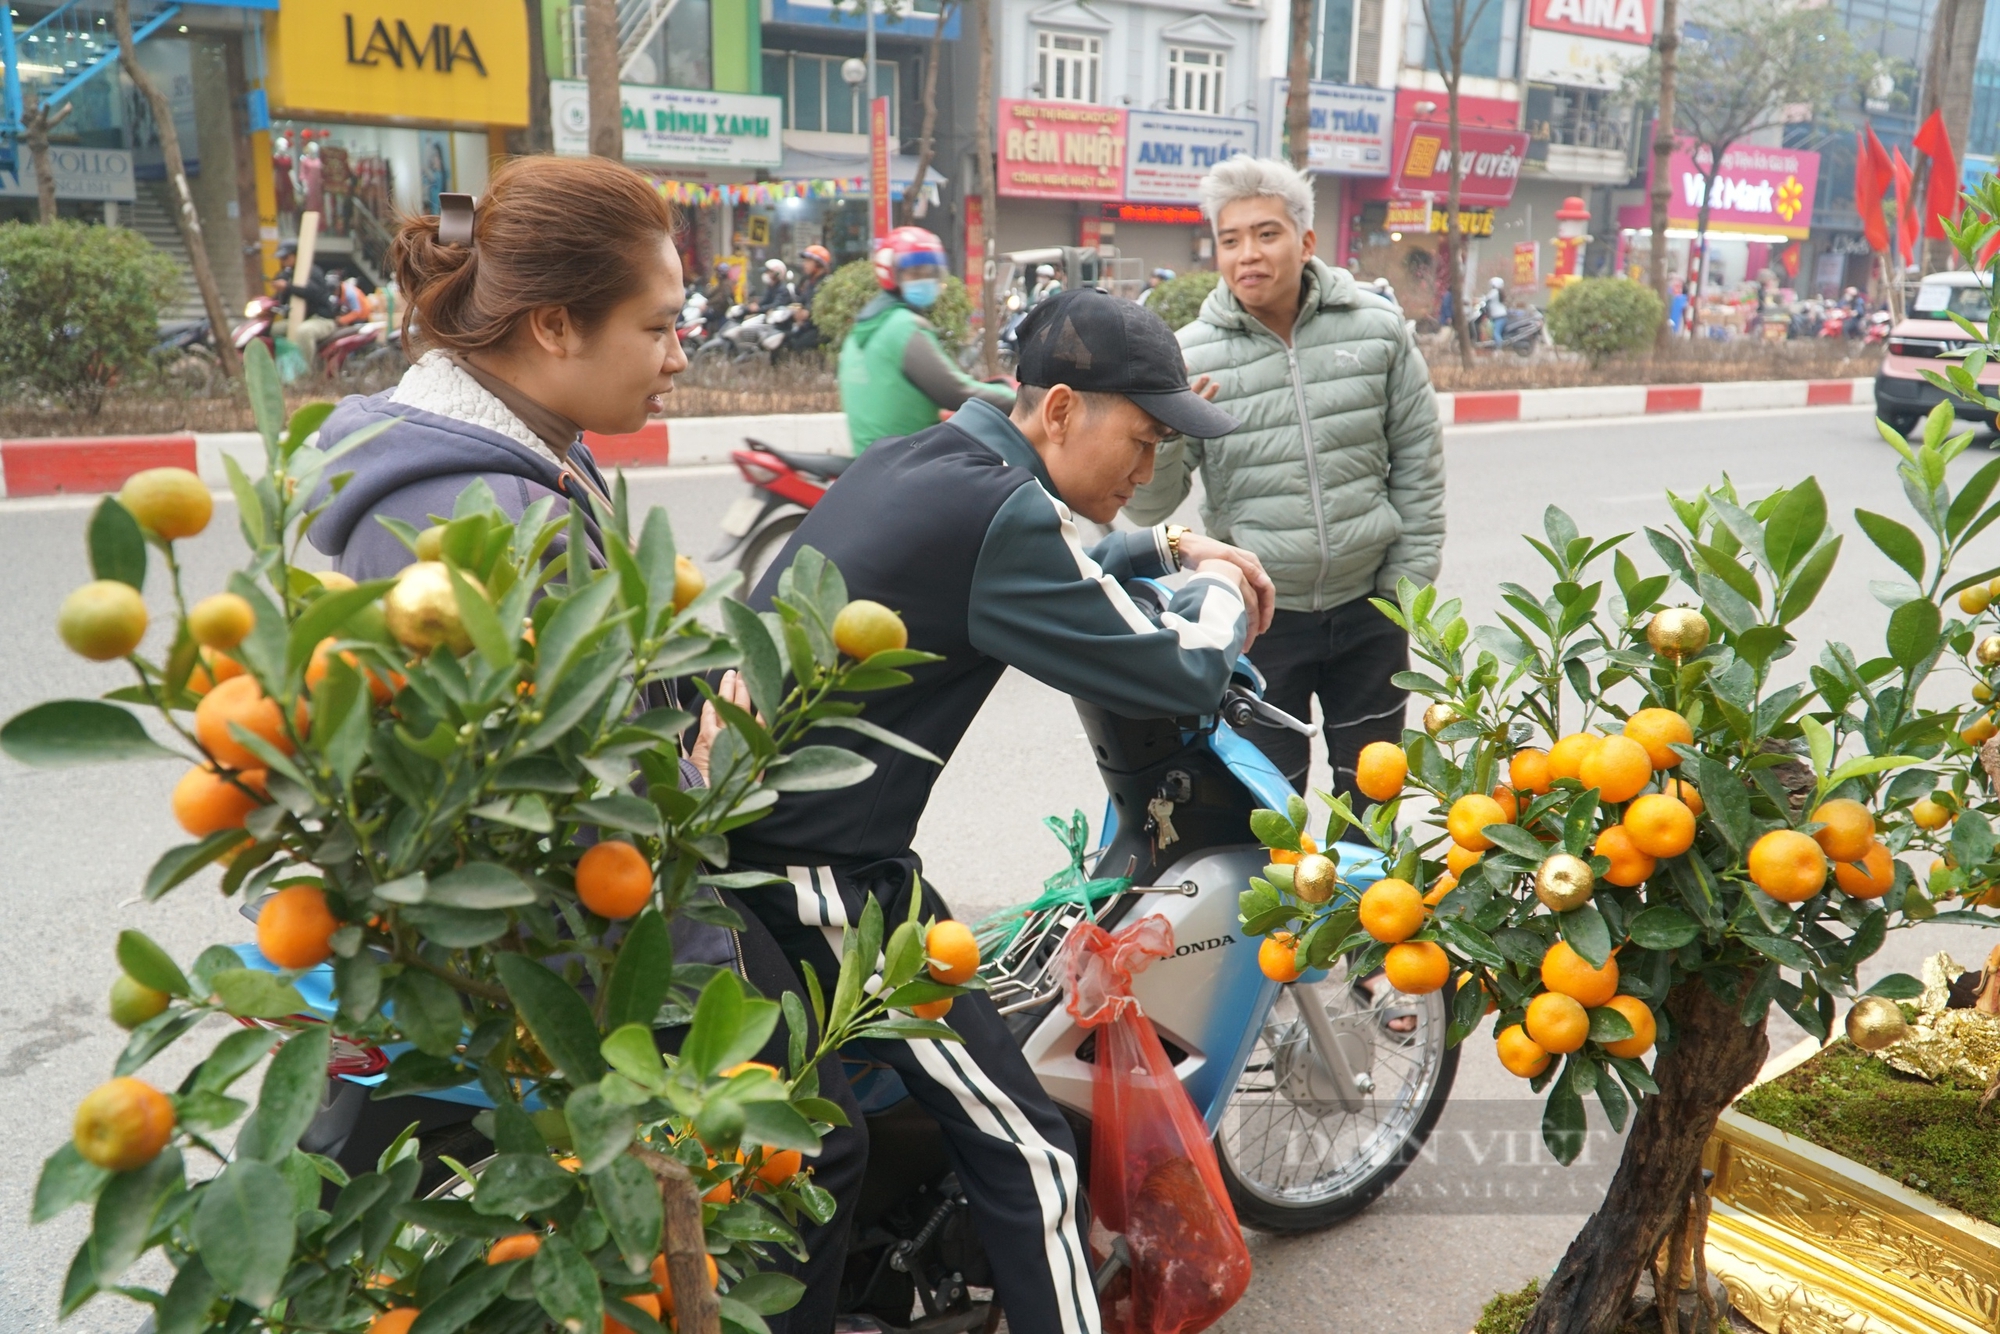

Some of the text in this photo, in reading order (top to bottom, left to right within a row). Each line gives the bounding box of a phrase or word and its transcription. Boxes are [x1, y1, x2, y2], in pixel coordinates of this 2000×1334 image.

[344, 12, 487, 76] LAMIA
[1006, 118, 1125, 177] RÈM NHẬT
[1138, 141, 1182, 166] ANH
[1436, 149, 1475, 181] NỰ
[58, 179, 111, 194] NGLISH
[1161, 934, 1236, 961] ONDA
